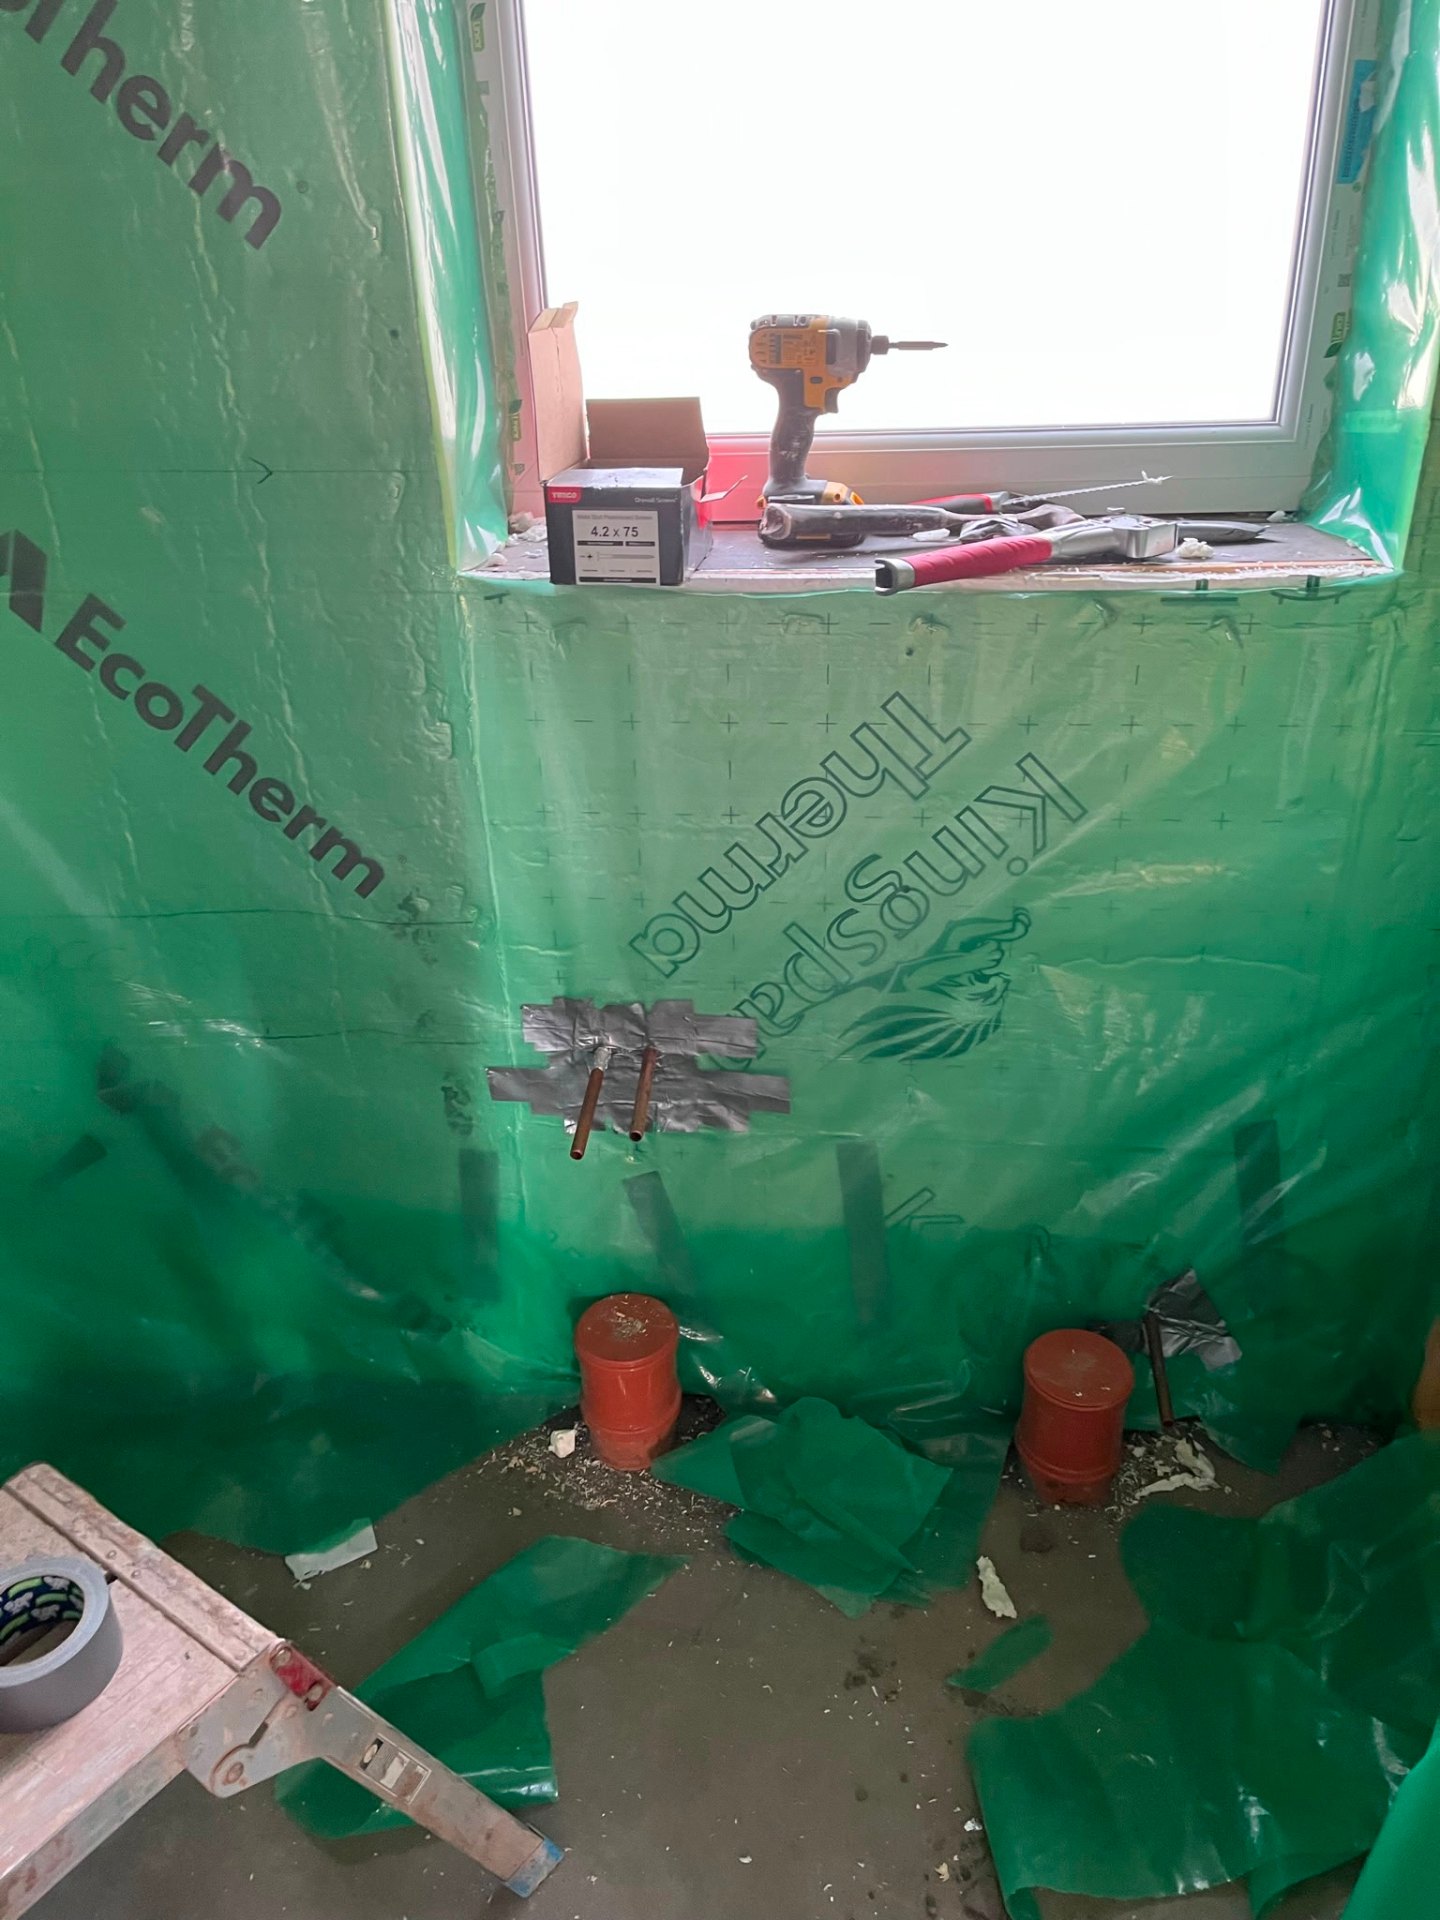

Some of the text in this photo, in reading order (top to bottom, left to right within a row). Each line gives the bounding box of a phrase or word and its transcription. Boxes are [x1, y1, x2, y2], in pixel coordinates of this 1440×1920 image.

[590, 526, 639, 538] 4.2 x 75
[54, 593, 386, 899] EcoTherm
[629, 691, 972, 978] Therma
